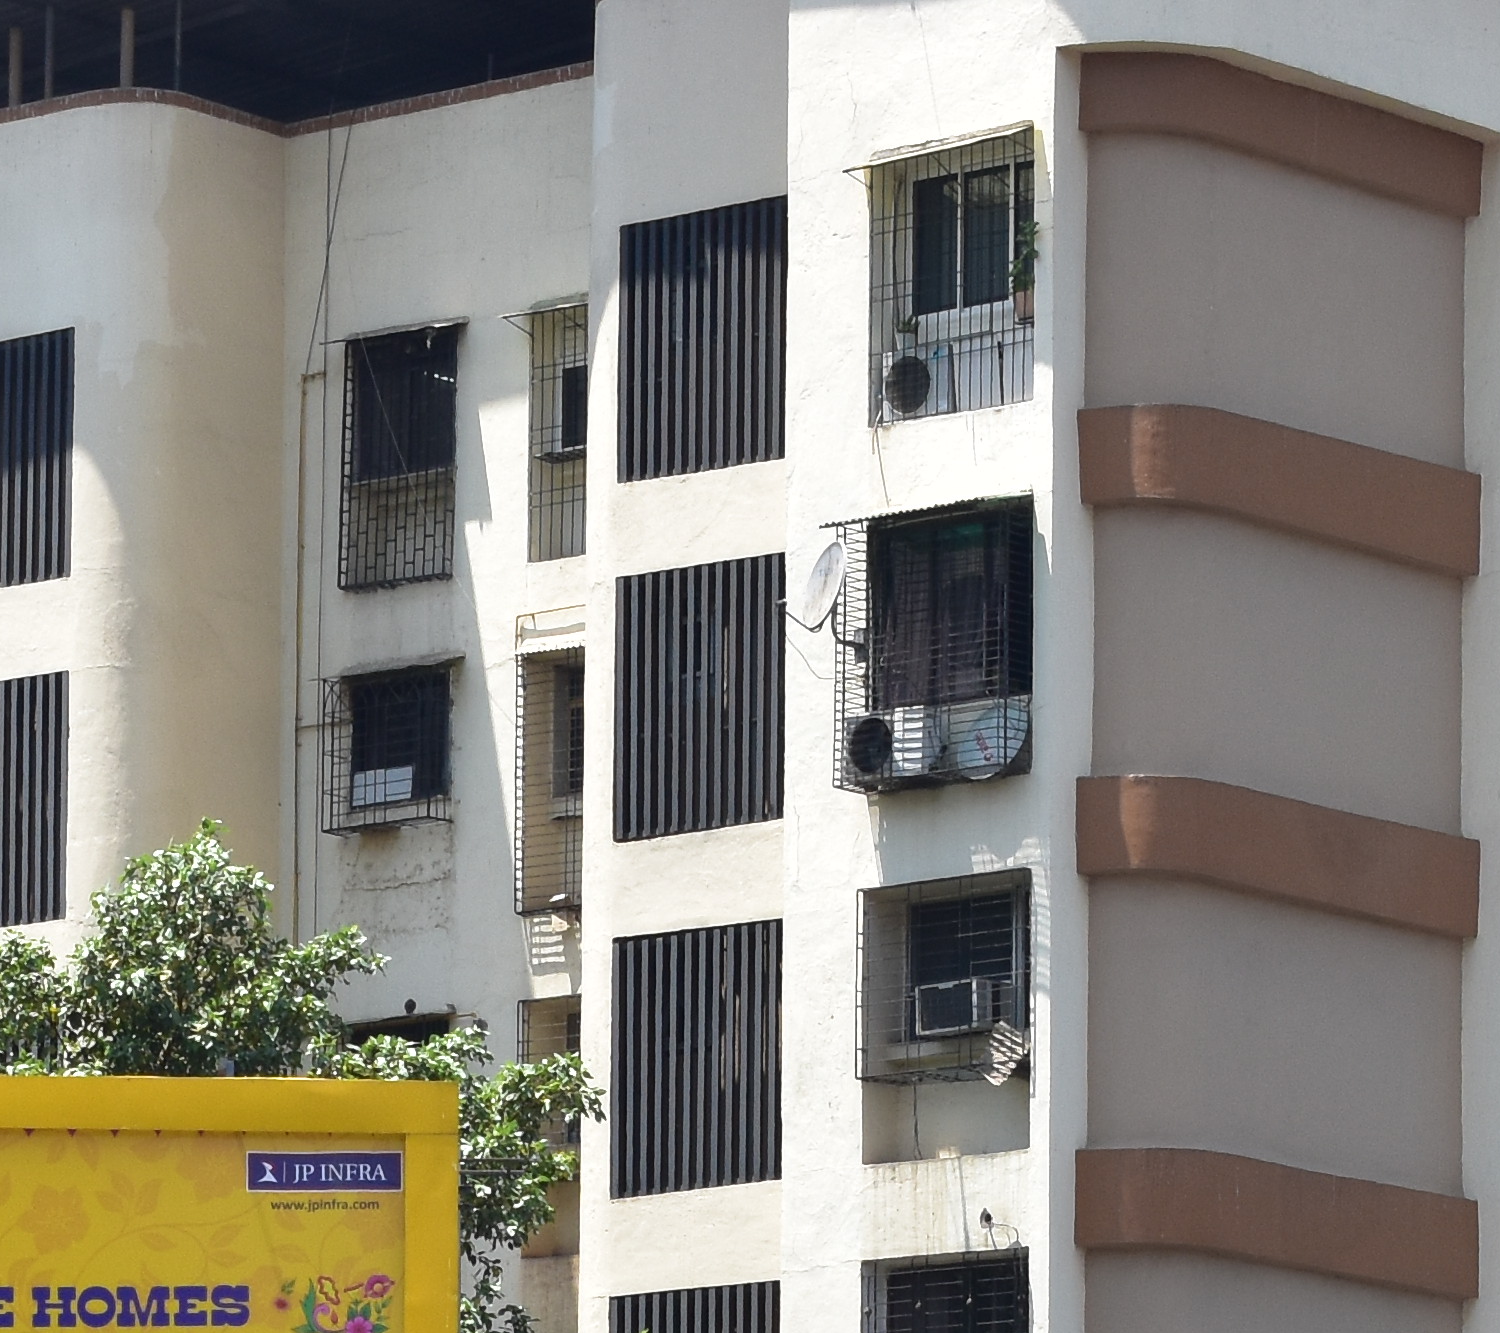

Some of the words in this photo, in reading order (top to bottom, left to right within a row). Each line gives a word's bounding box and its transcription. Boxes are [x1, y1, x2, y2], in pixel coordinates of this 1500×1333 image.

[291, 1163, 315, 1183] JP
[318, 1163, 388, 1183] INFRA
[270, 1199, 380, 1212] www.jpinfra.com
[32, 1284, 251, 1328] HOMES
